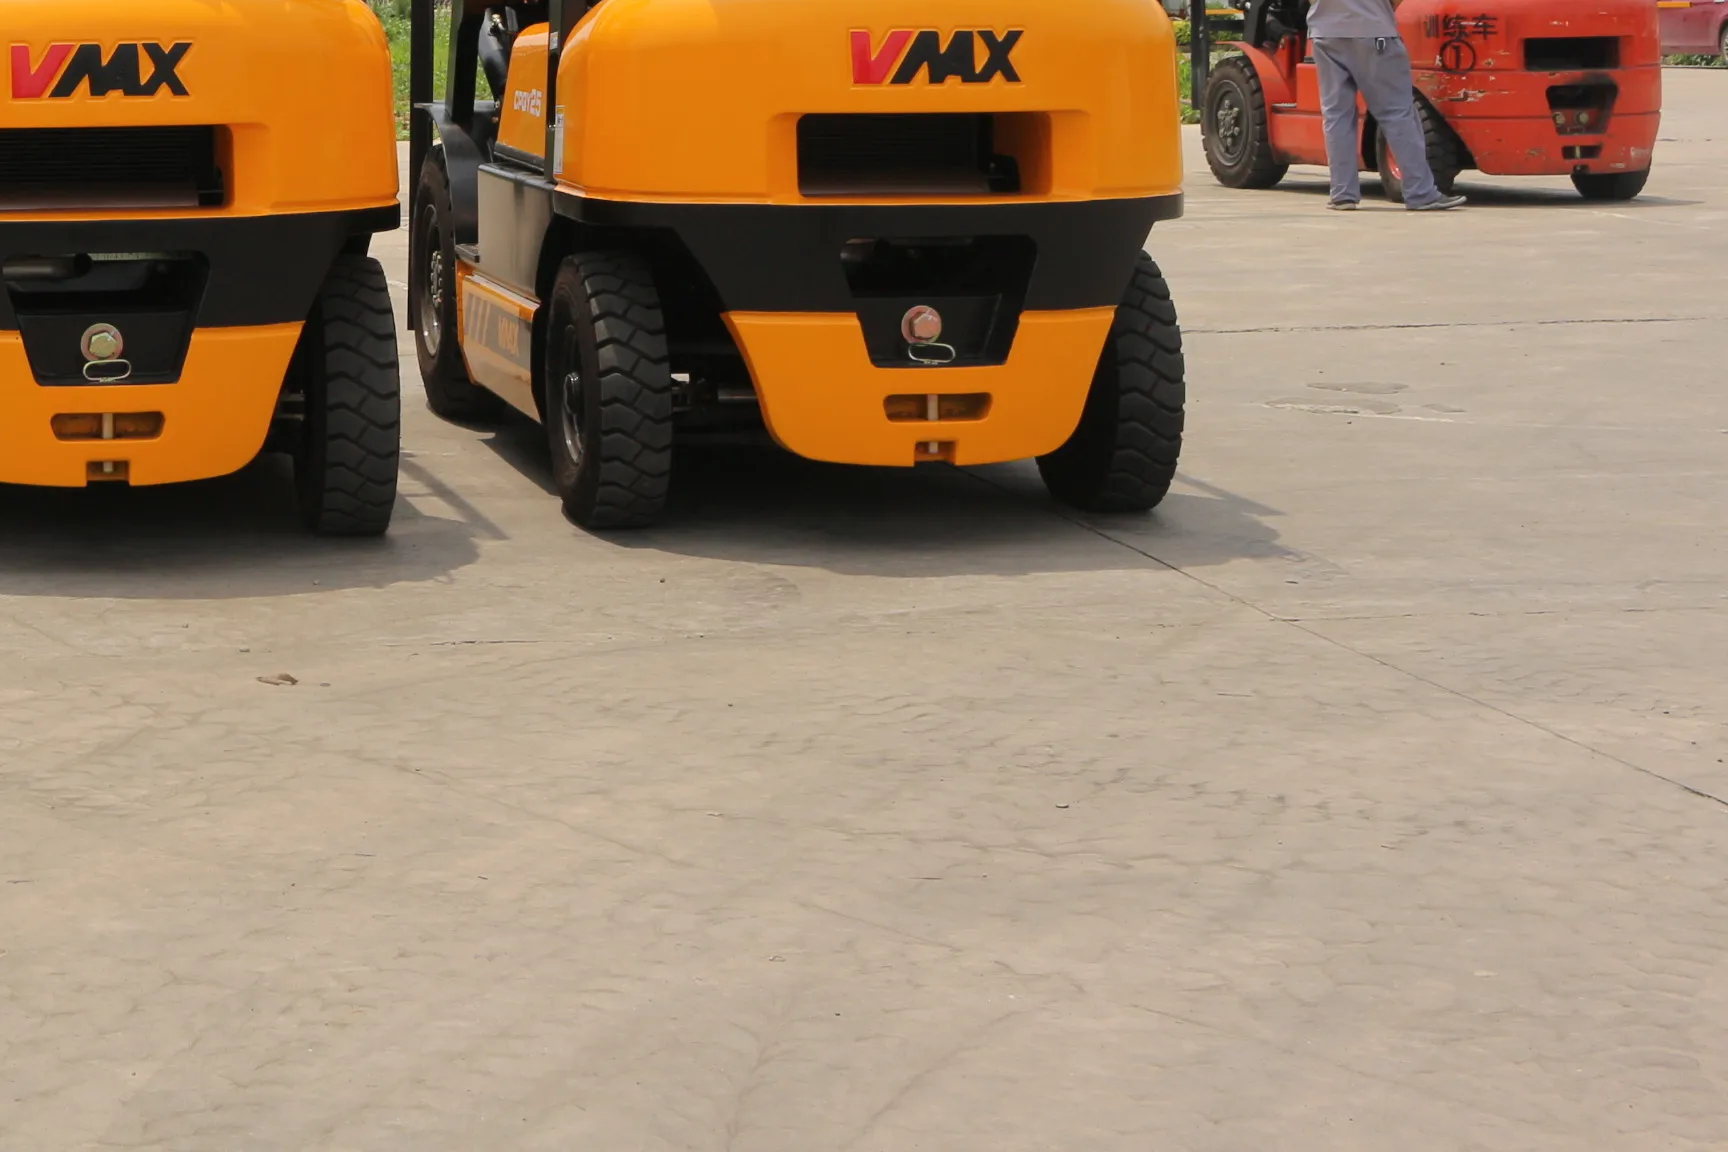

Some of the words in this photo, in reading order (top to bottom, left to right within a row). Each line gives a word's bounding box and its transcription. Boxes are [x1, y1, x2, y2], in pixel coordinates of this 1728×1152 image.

[1423, 13, 1498, 40] 训练车
[10, 42, 193, 99] VMAX
[849, 30, 1025, 85] VMAX
